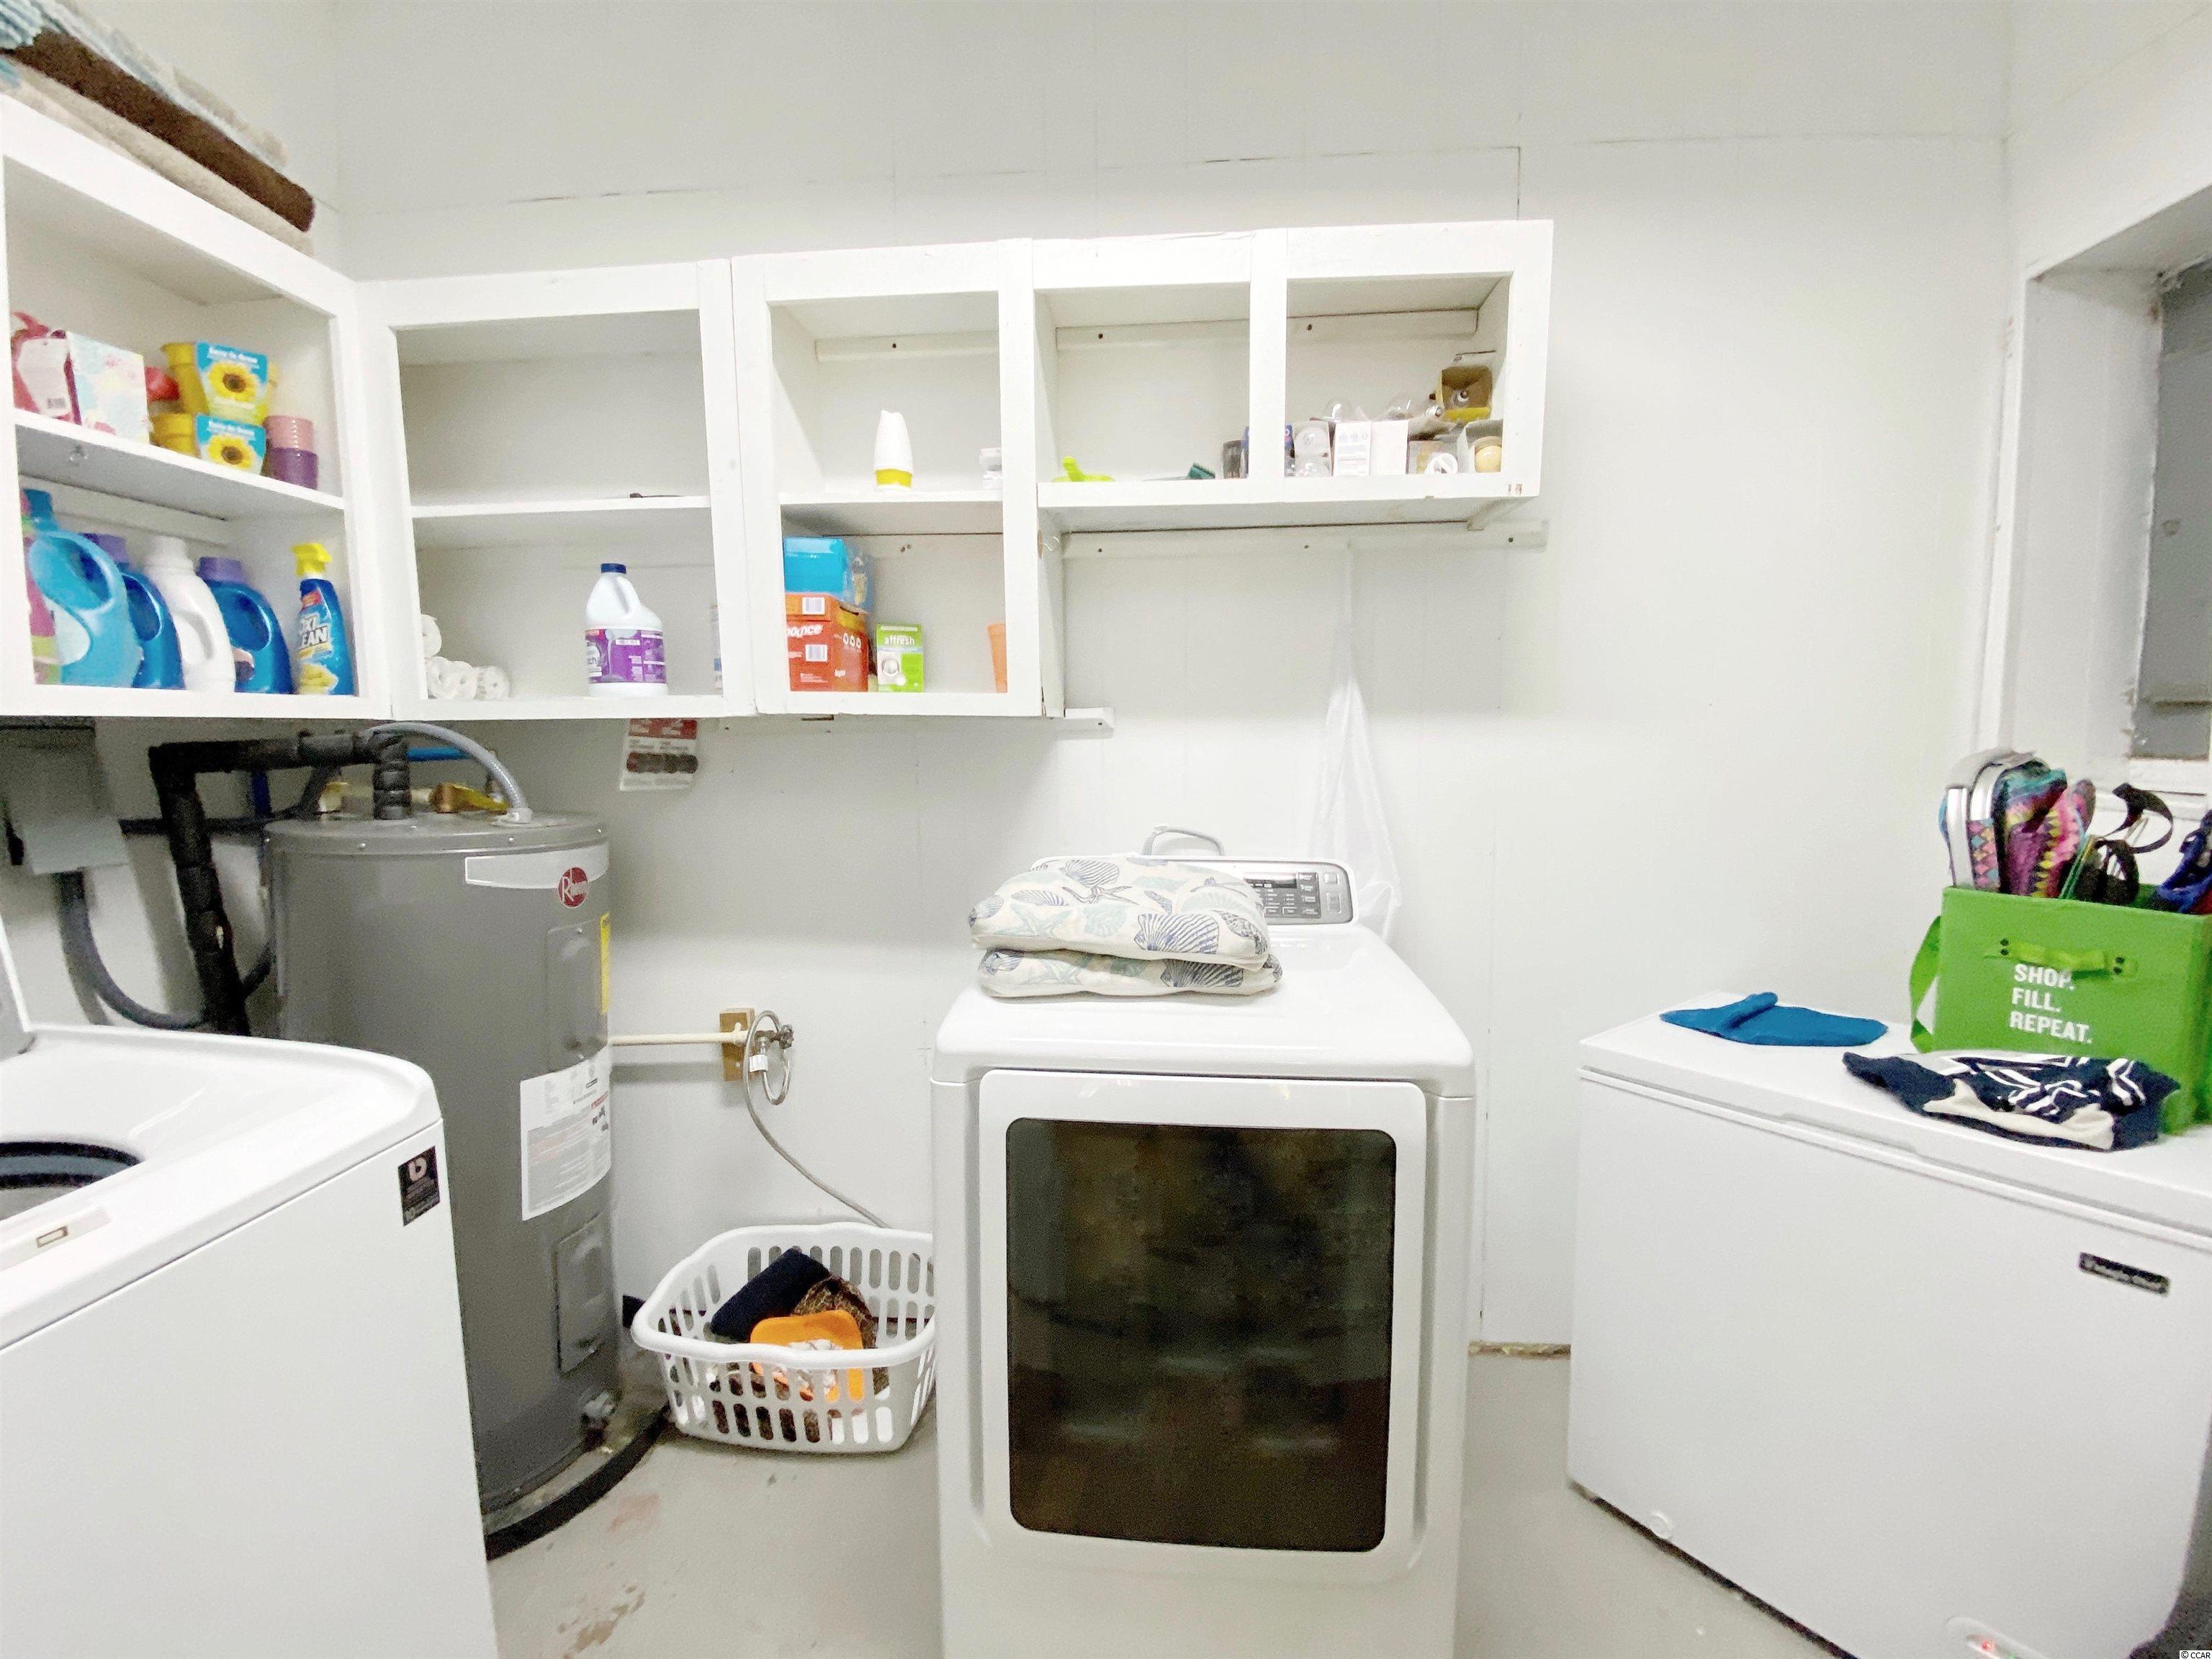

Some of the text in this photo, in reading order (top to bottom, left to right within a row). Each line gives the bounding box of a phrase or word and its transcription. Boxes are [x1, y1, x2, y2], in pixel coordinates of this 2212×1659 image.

[884, 635, 915, 645] affresh
[2014, 963, 2074, 990] SHOP.
[2012, 987, 2062, 1012] FILL.
[2009, 1011, 2092, 1043] REPEAT.
